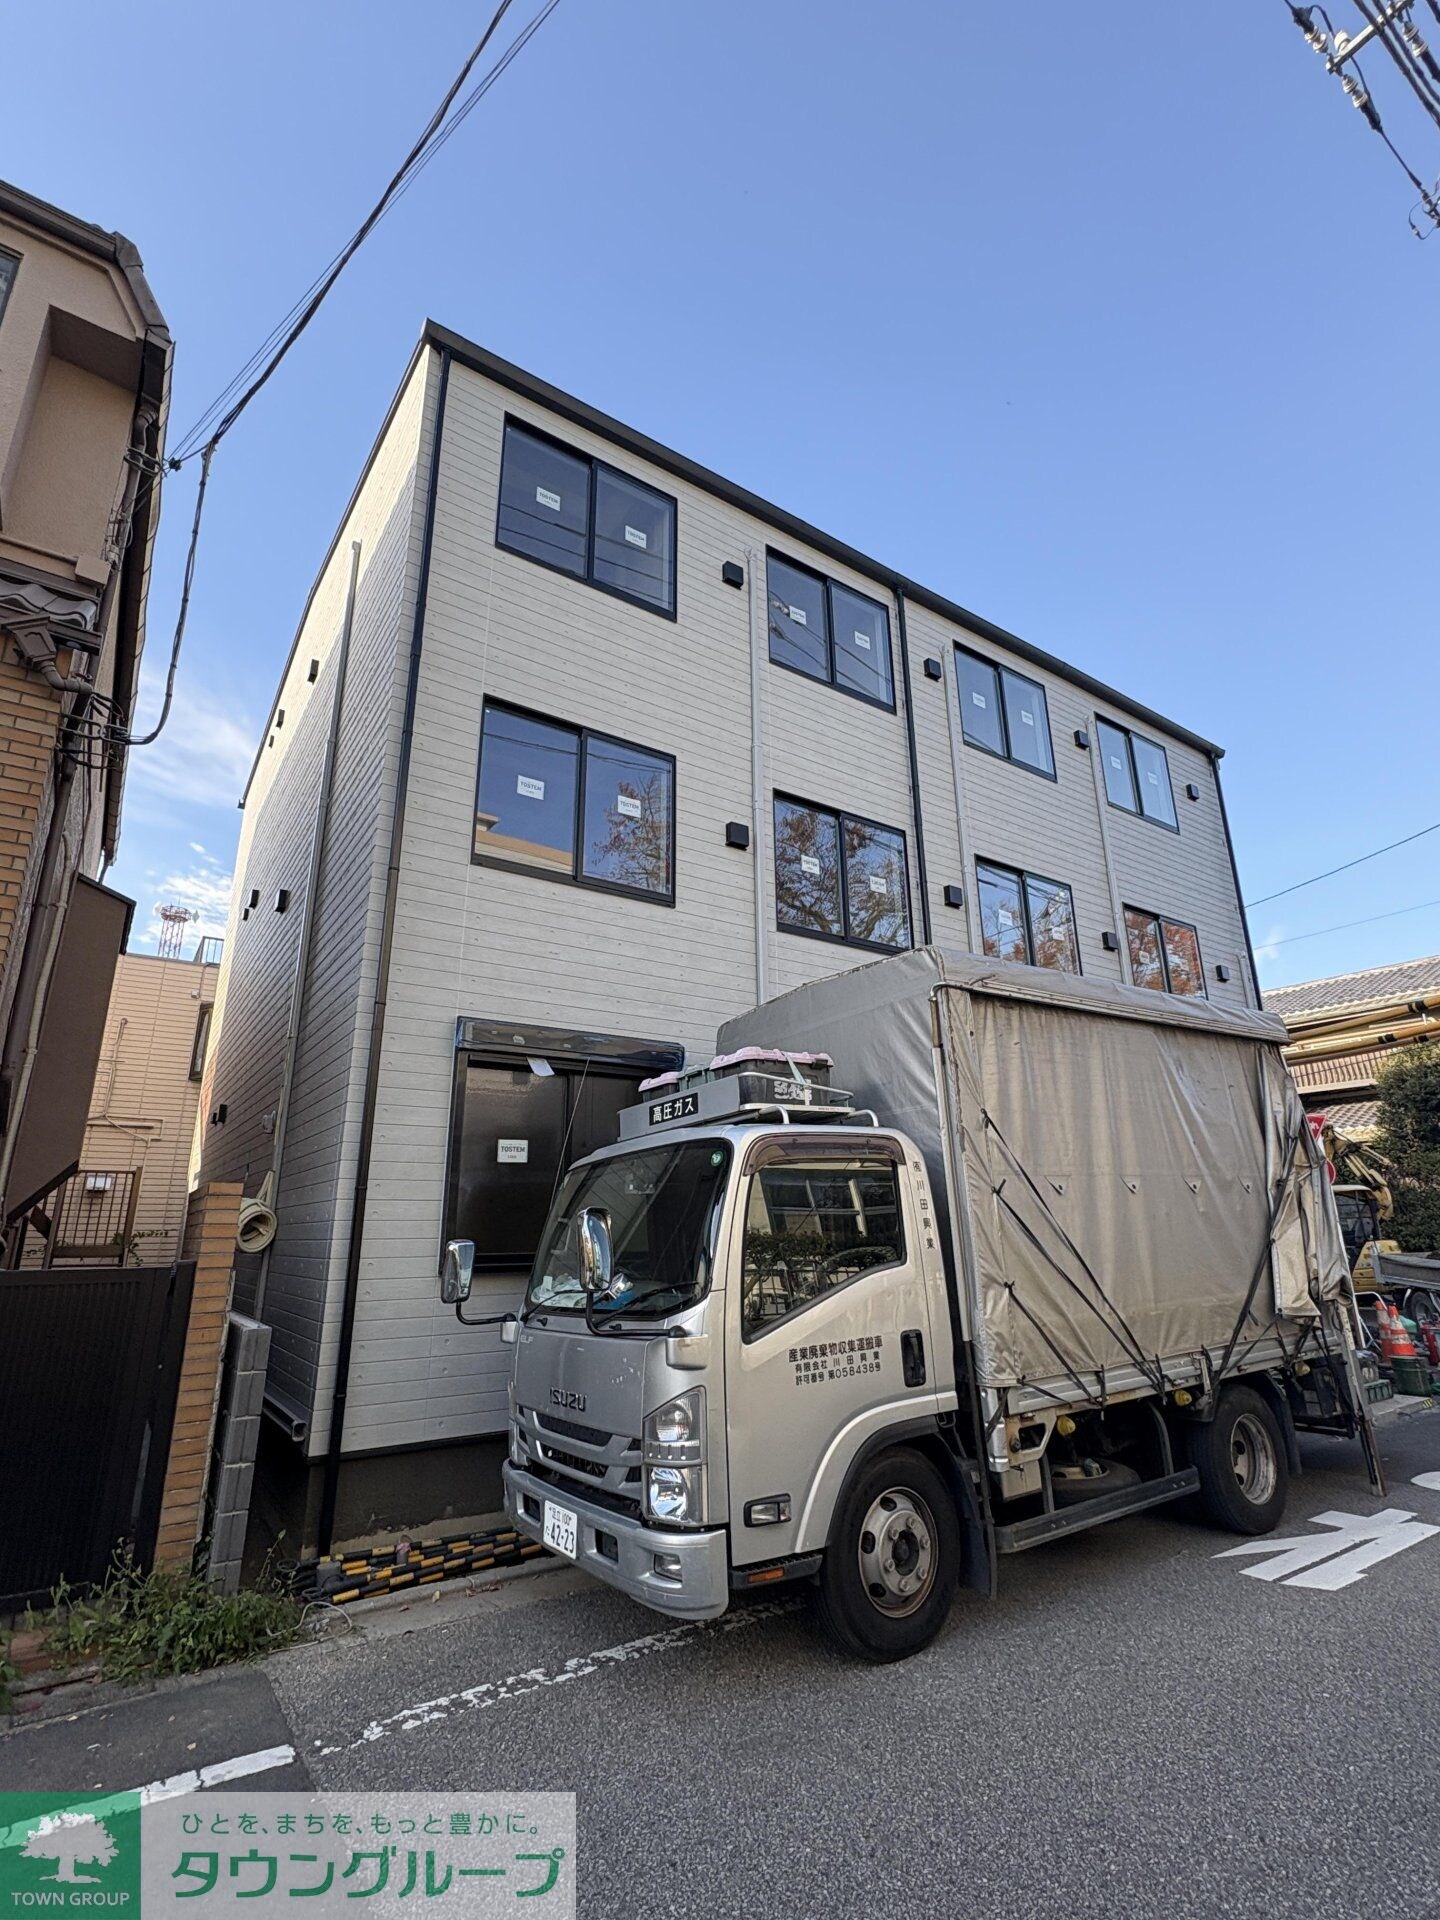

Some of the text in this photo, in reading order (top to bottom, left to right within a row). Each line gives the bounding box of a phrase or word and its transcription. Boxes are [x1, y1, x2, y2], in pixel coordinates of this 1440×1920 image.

[520, 780, 542, 792] TOSTEM
[653, 1098, 694, 1123] 高圧ガス
[500, 1145, 526, 1153] TOSTEM
[788, 1335, 883, 1363] 産業廃棄物収集運搬車
[549, 1387, 587, 1412] ISUZU
